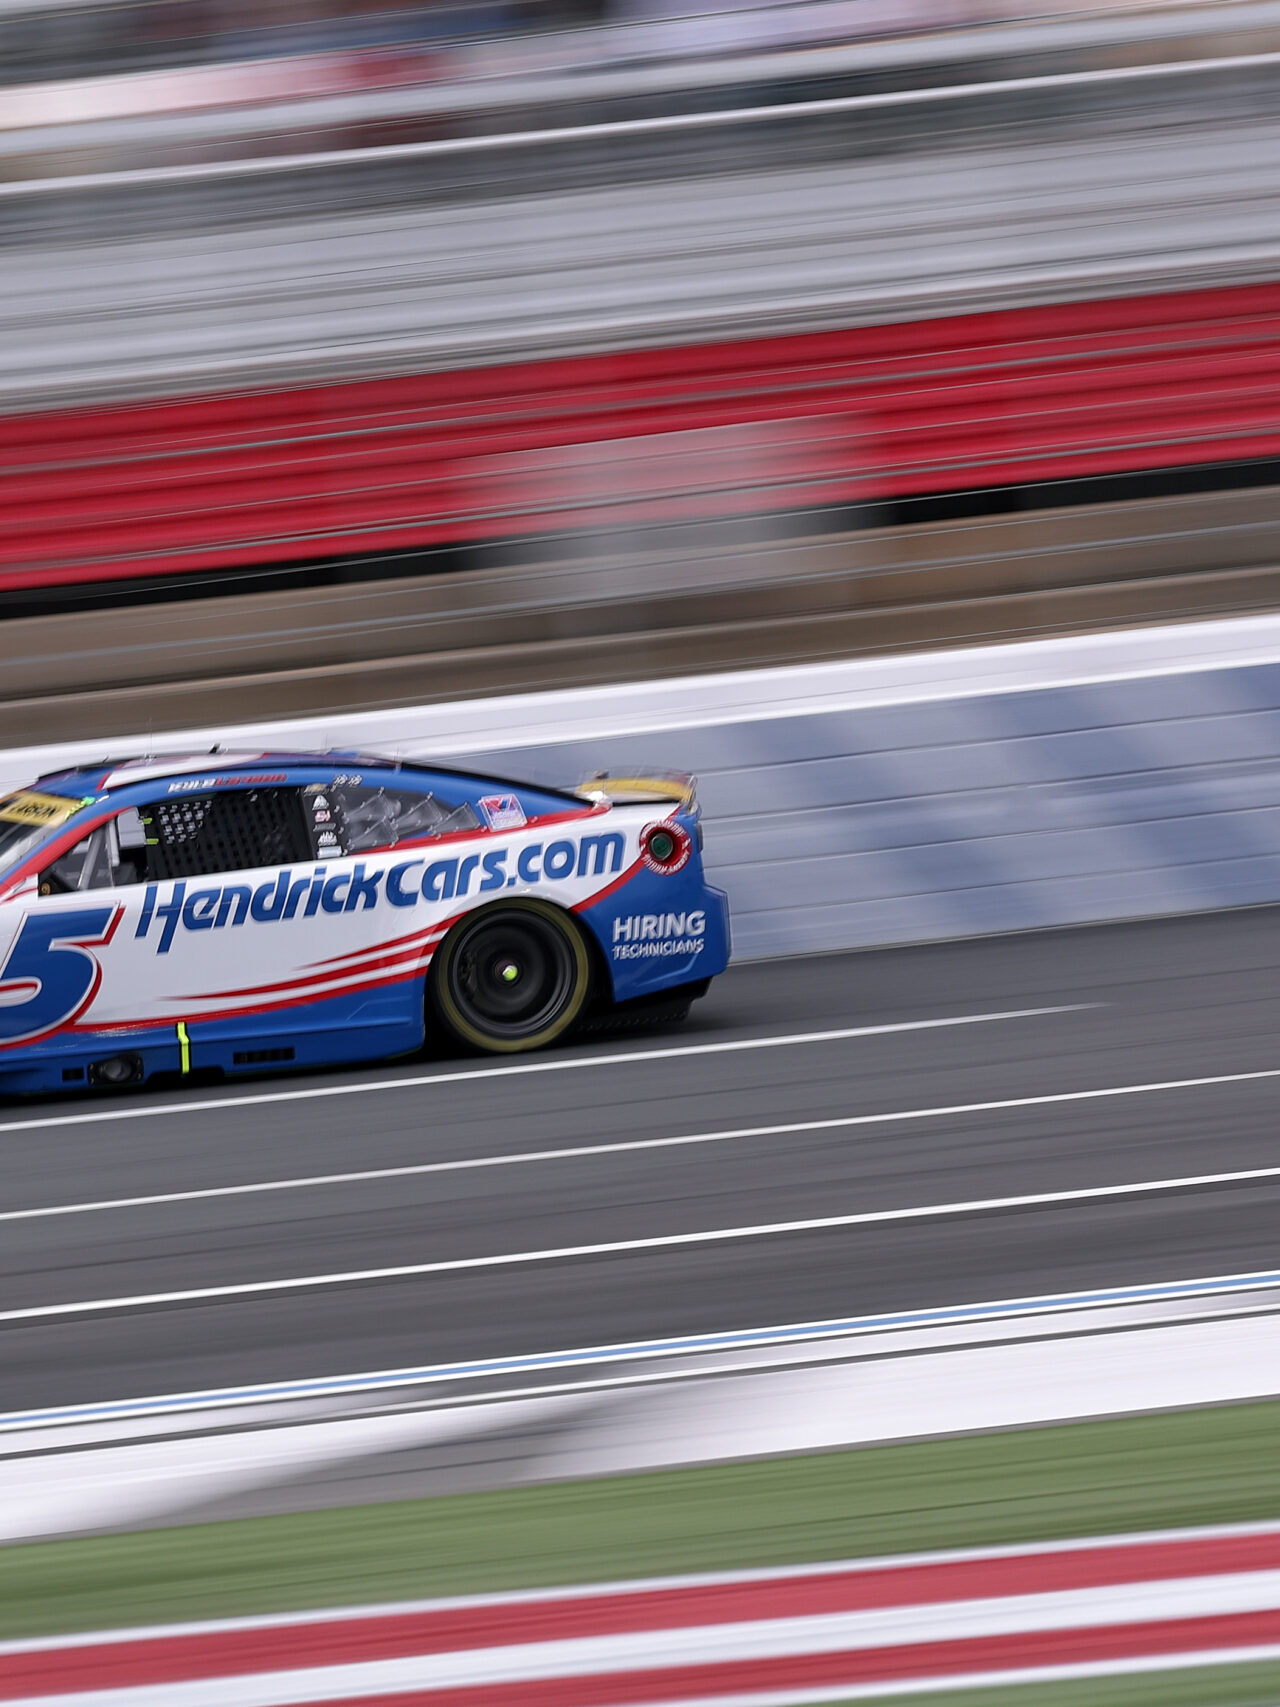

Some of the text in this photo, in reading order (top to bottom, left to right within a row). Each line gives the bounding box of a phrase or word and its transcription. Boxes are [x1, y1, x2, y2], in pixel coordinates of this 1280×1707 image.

[134, 832, 626, 955] HendrickCars.com
[612, 910, 706, 943] HIRING
[612, 938, 705, 960] TECHNICIANS
